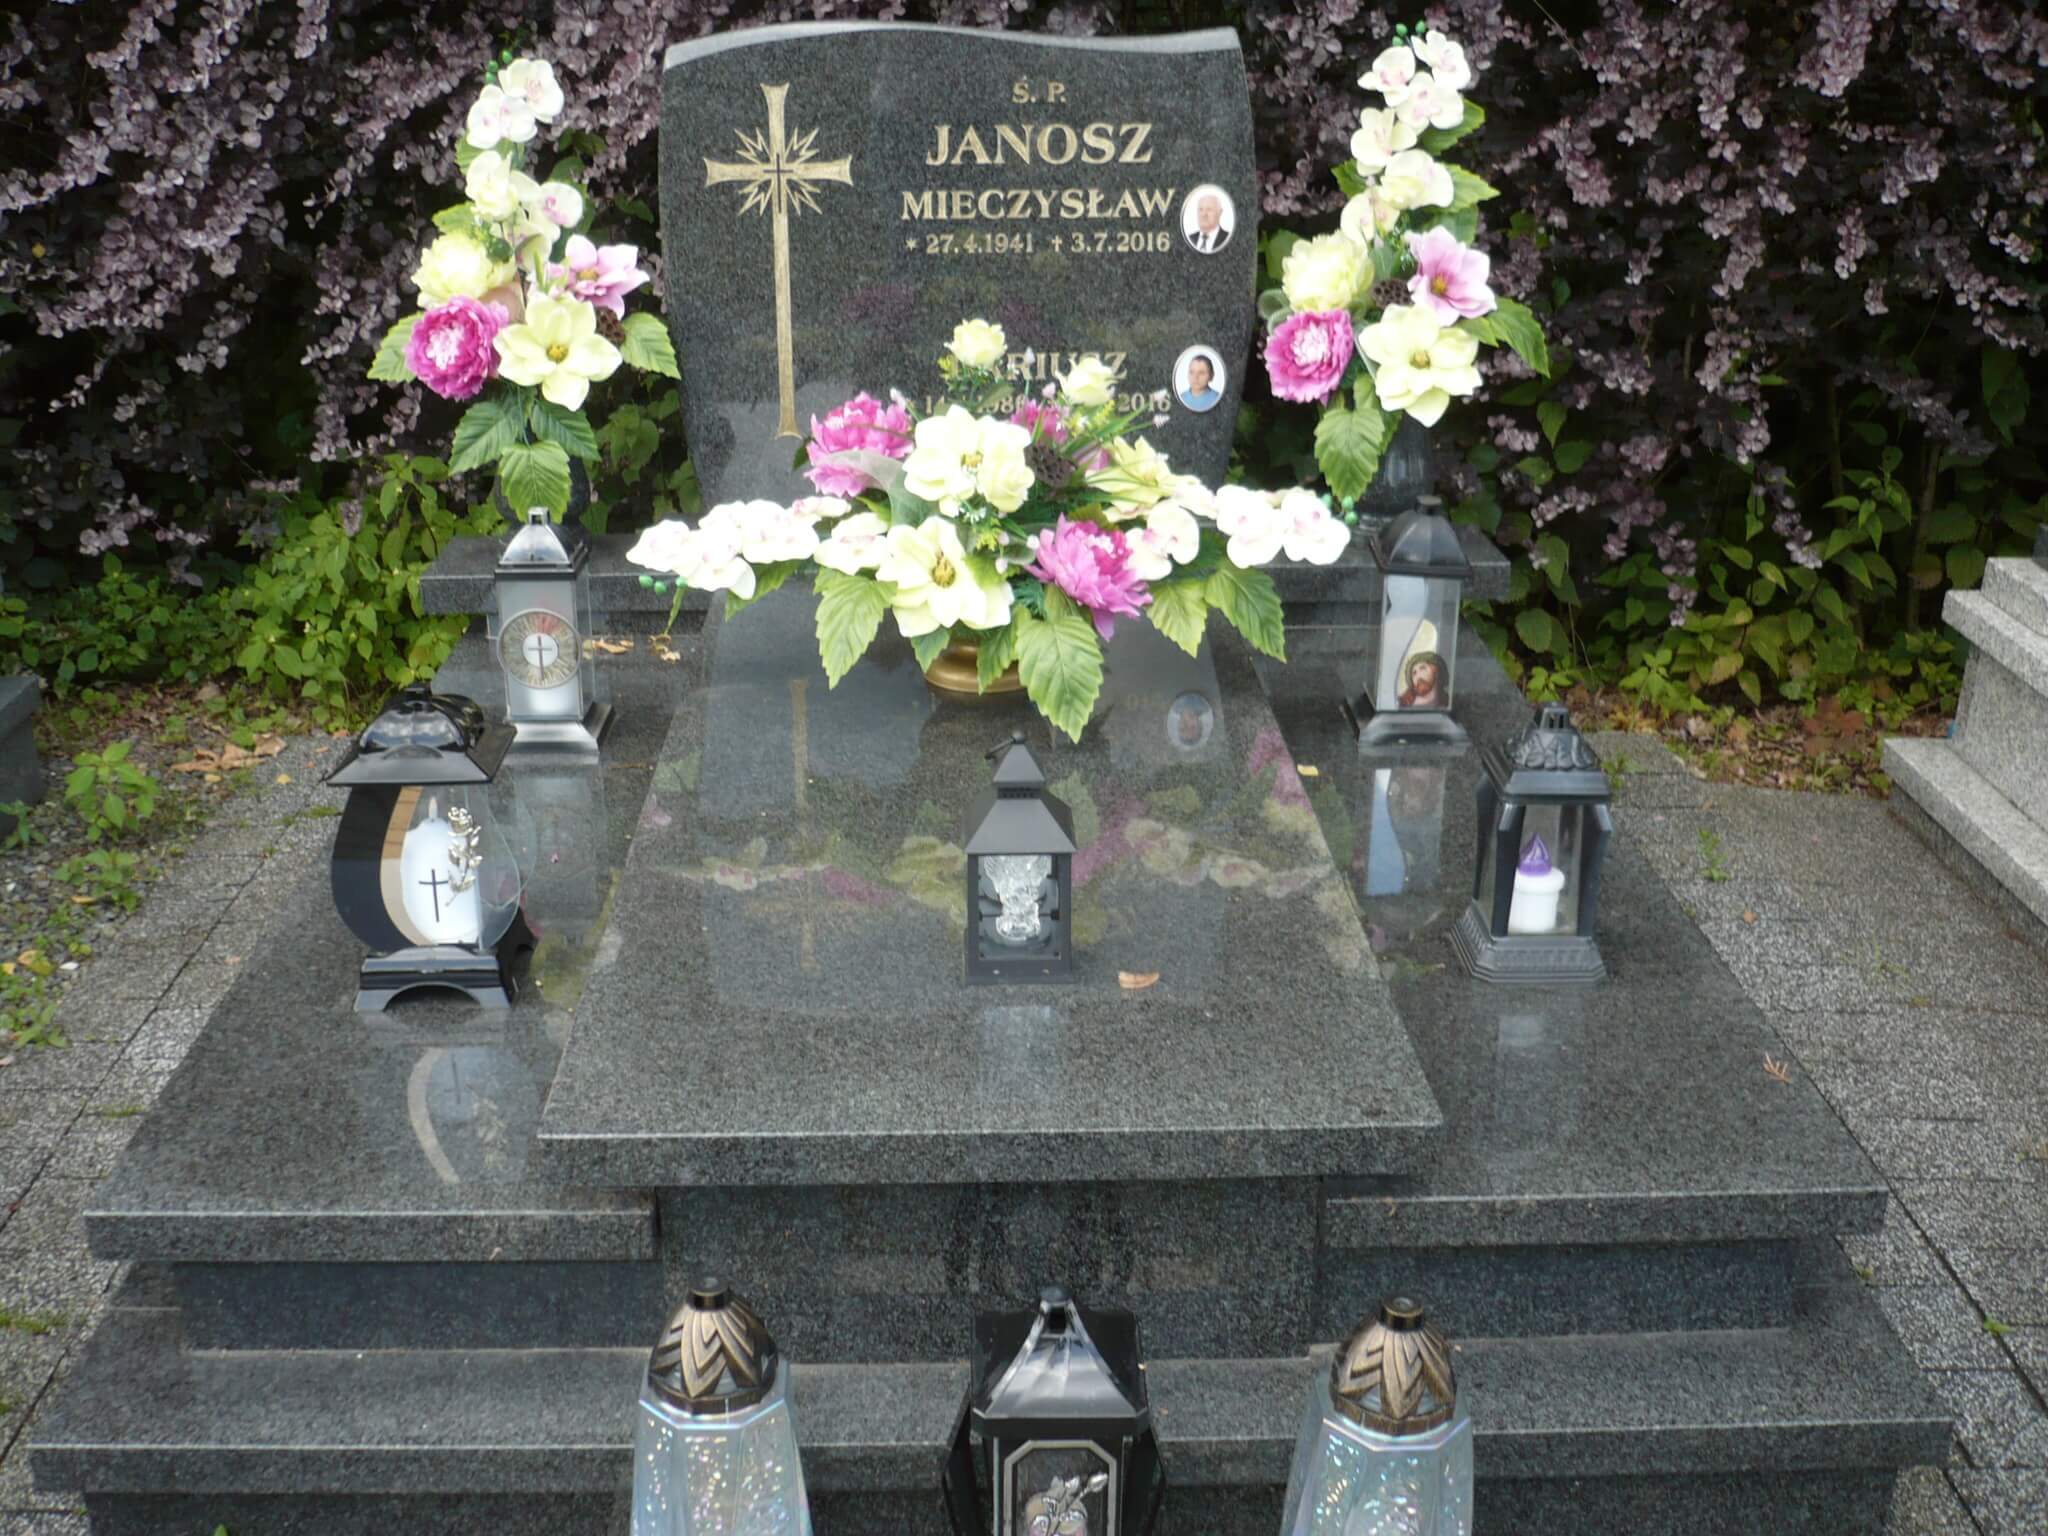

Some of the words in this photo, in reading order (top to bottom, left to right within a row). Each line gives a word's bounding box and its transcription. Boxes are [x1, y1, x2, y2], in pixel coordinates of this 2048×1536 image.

[926, 123, 1153, 165] JANOSZ
[901, 188, 1175, 220] MIECZYSŁAW
[926, 232, 1033, 254] 27.4.1941
[1071, 231, 1170, 253] 3.7.2016
